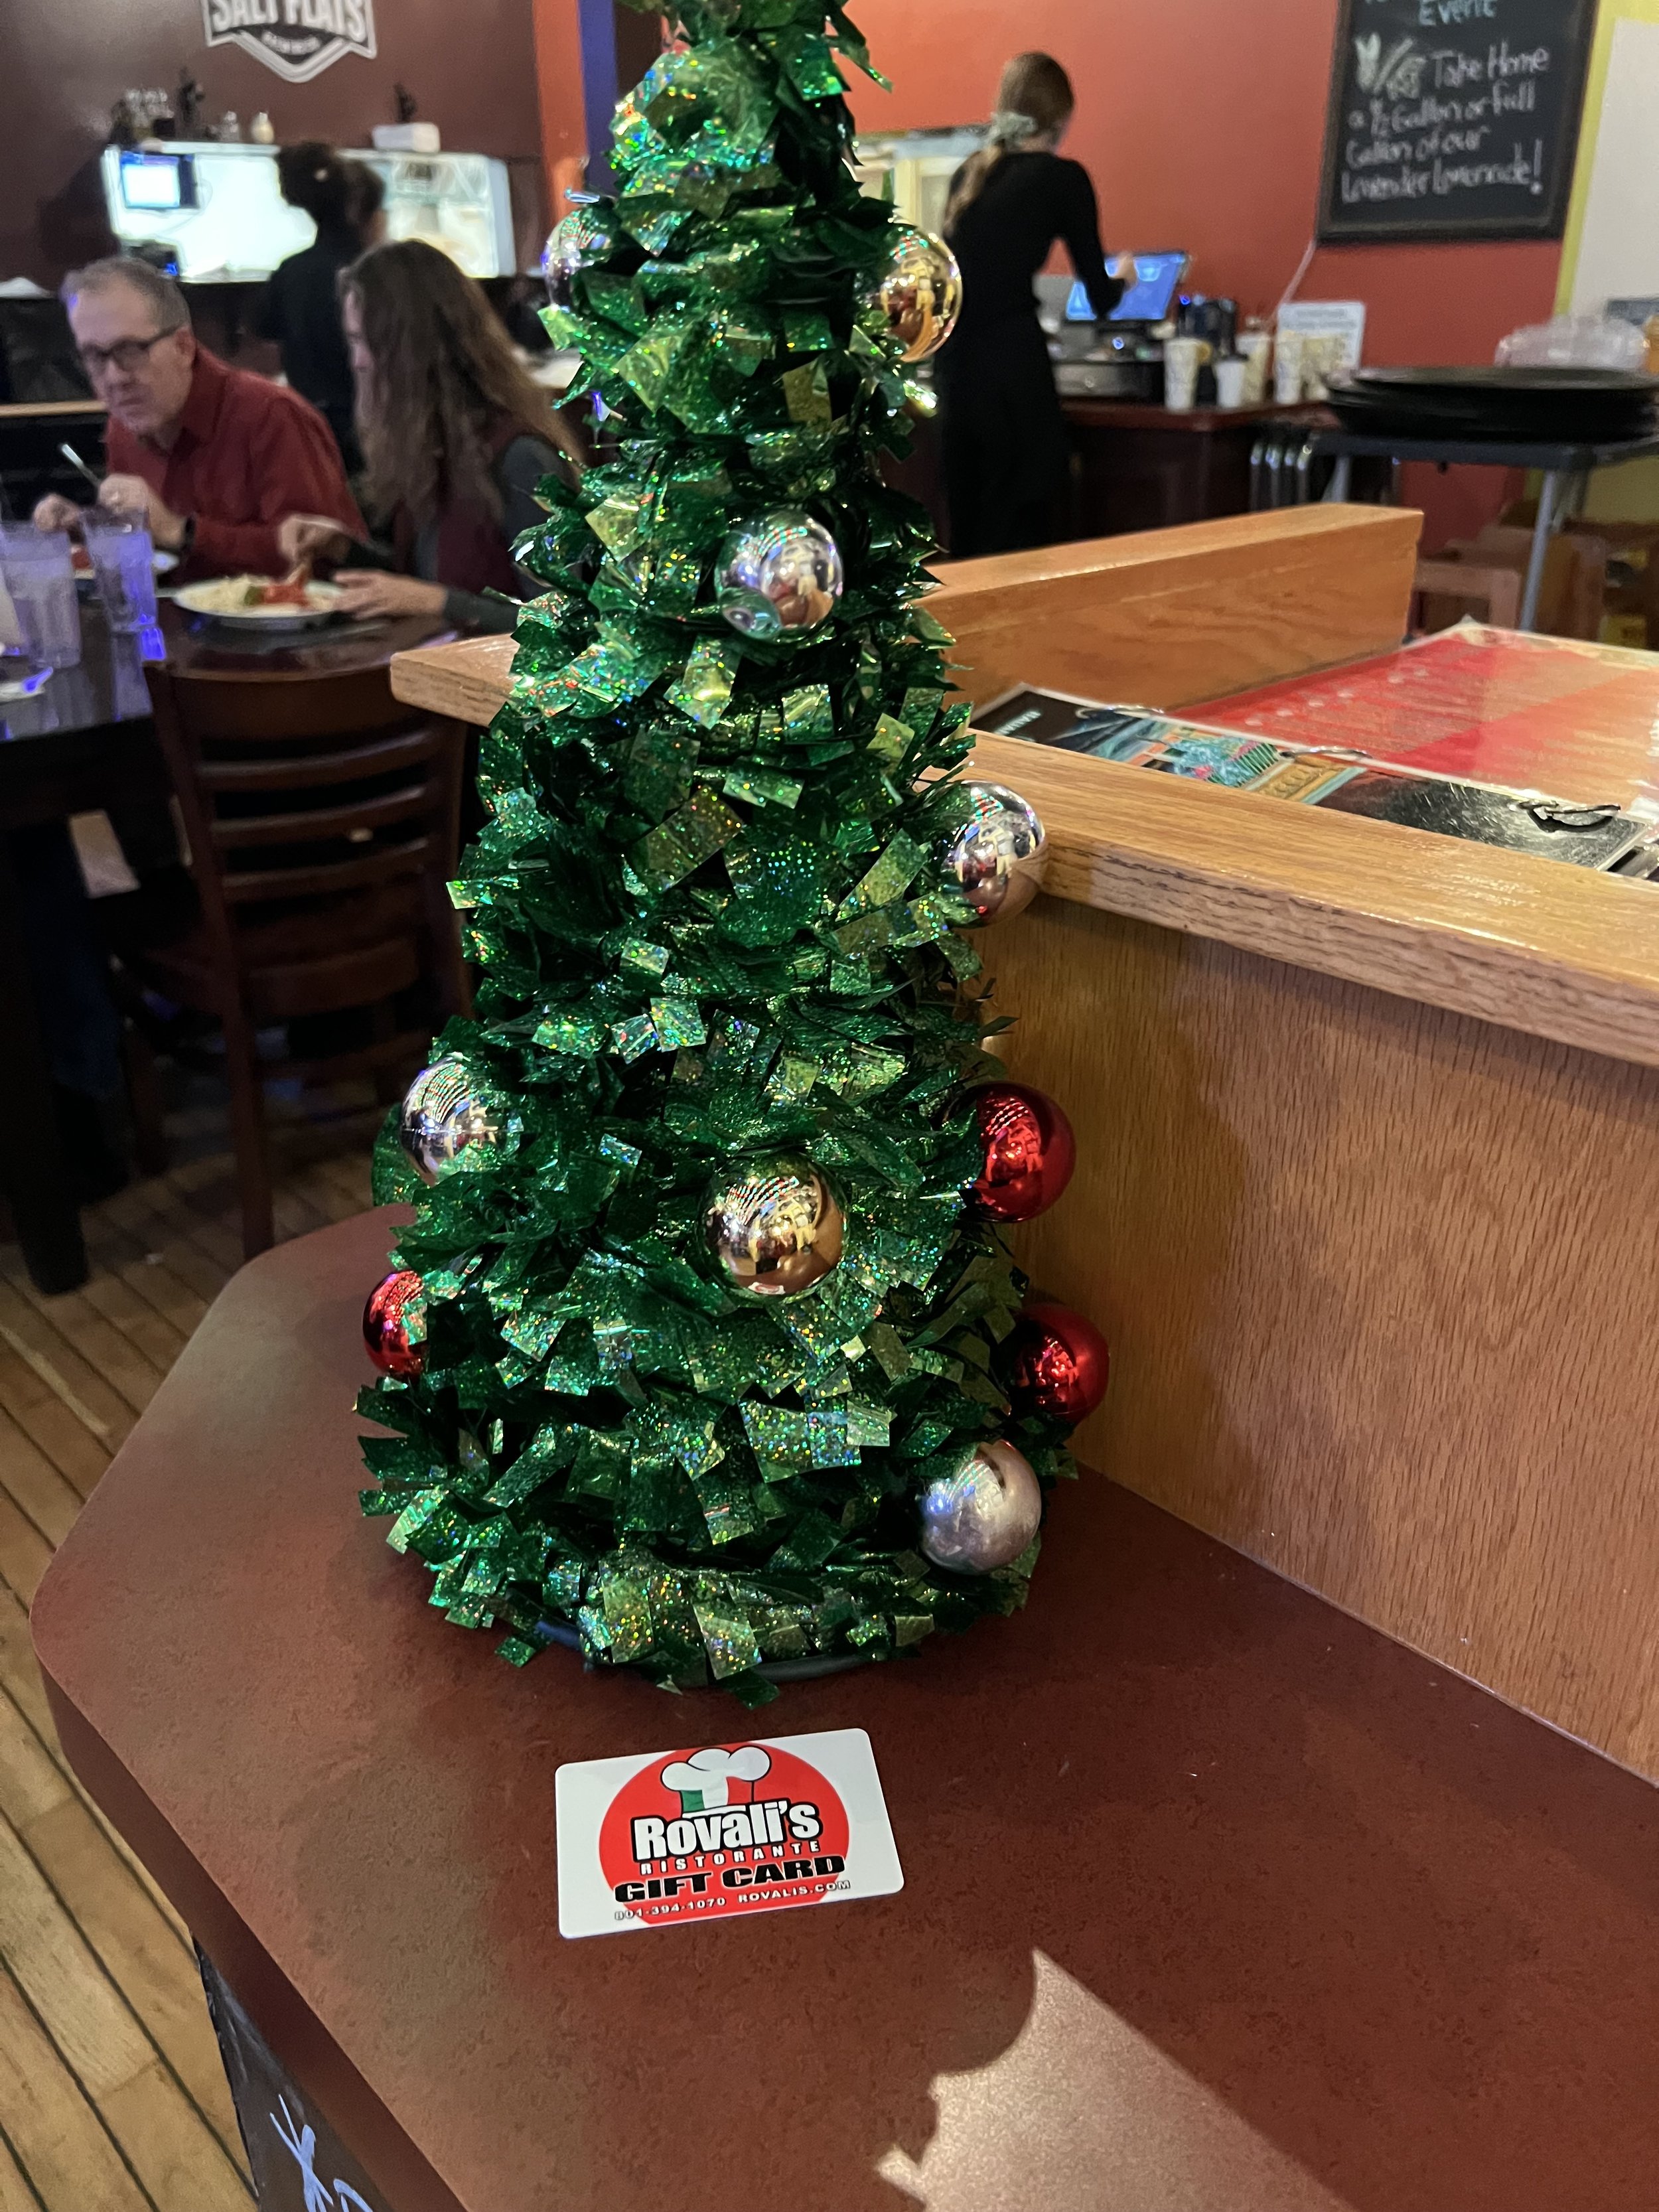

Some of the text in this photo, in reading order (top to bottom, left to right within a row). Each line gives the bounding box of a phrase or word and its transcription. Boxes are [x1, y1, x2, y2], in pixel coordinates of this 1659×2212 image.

[1430, 38, 1550, 89] Take Home
[632, 1799, 822, 1861] Rovali's
[614, 1856, 845, 1903] GIFT CARD
[640, 1840, 820, 1876] RISTORANTE
[614, 1880, 851, 1921] 801-394-1070 ROVALIS.COM
